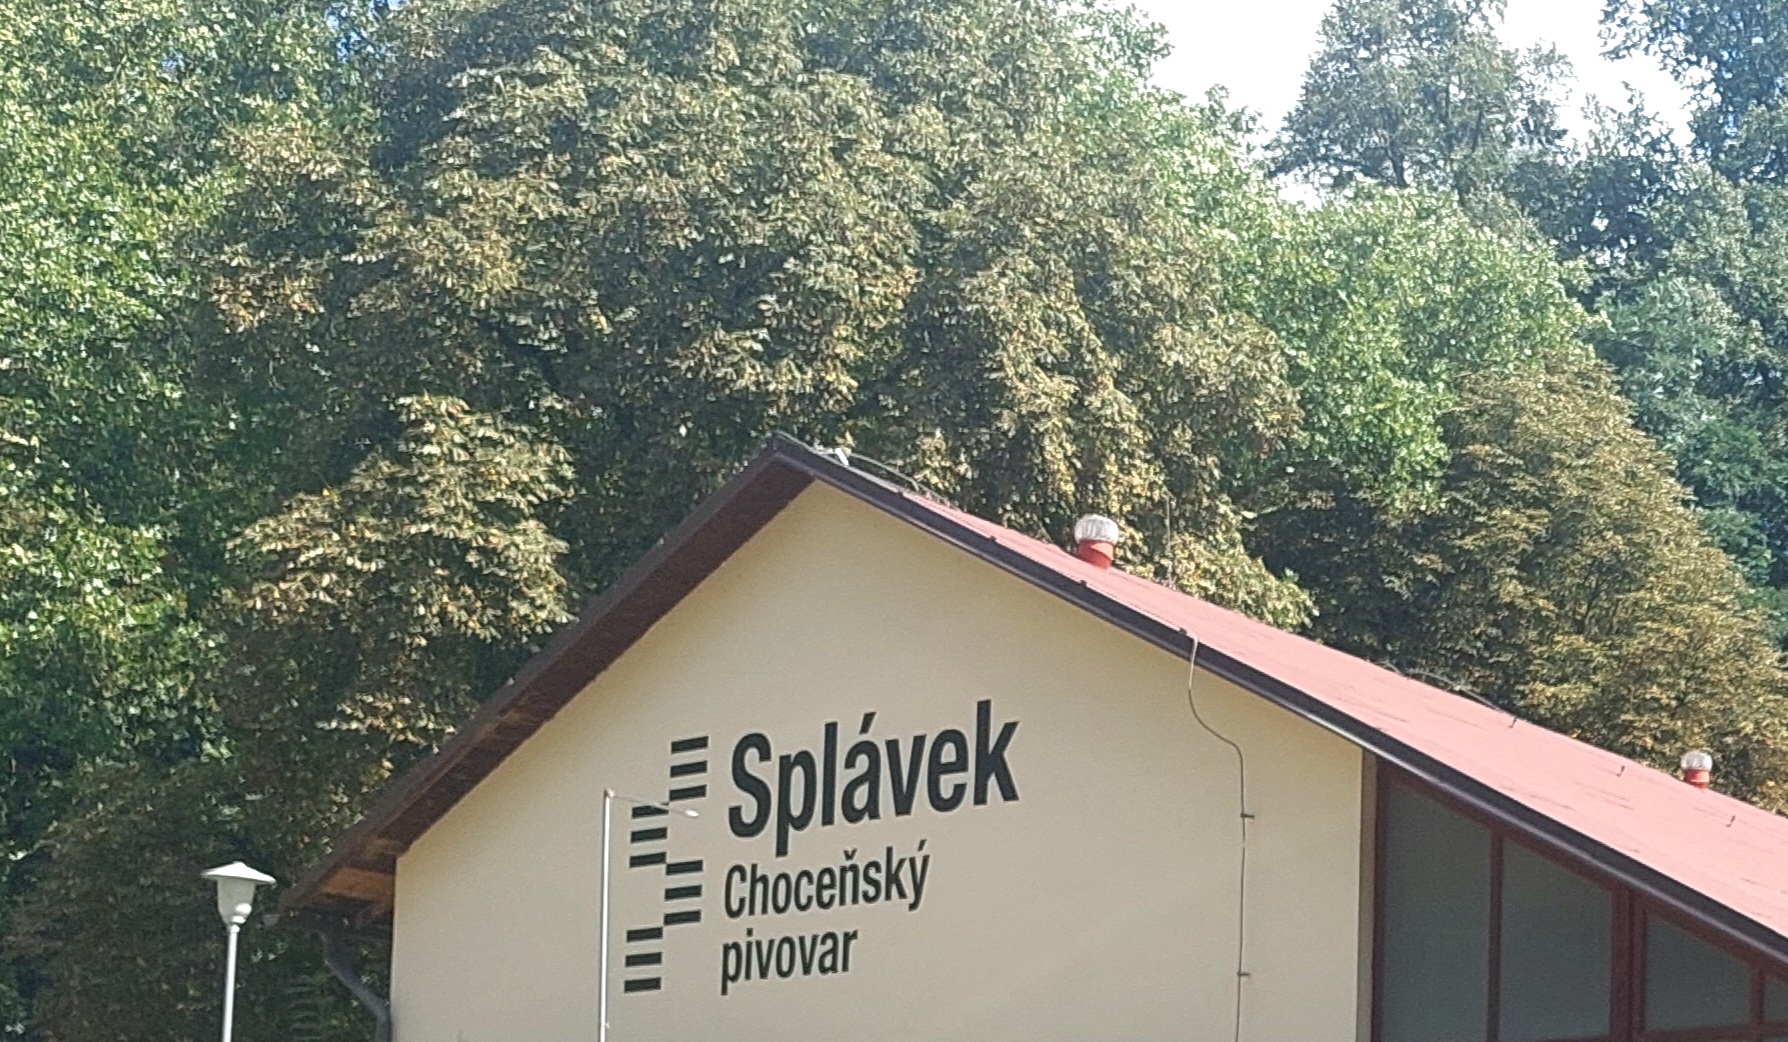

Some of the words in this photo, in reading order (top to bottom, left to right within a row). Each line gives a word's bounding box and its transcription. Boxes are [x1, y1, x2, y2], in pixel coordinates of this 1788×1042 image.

[728, 699, 1020, 858] Splávek
[723, 838, 930, 919] Choceňský
[720, 927, 859, 996] pivovar
